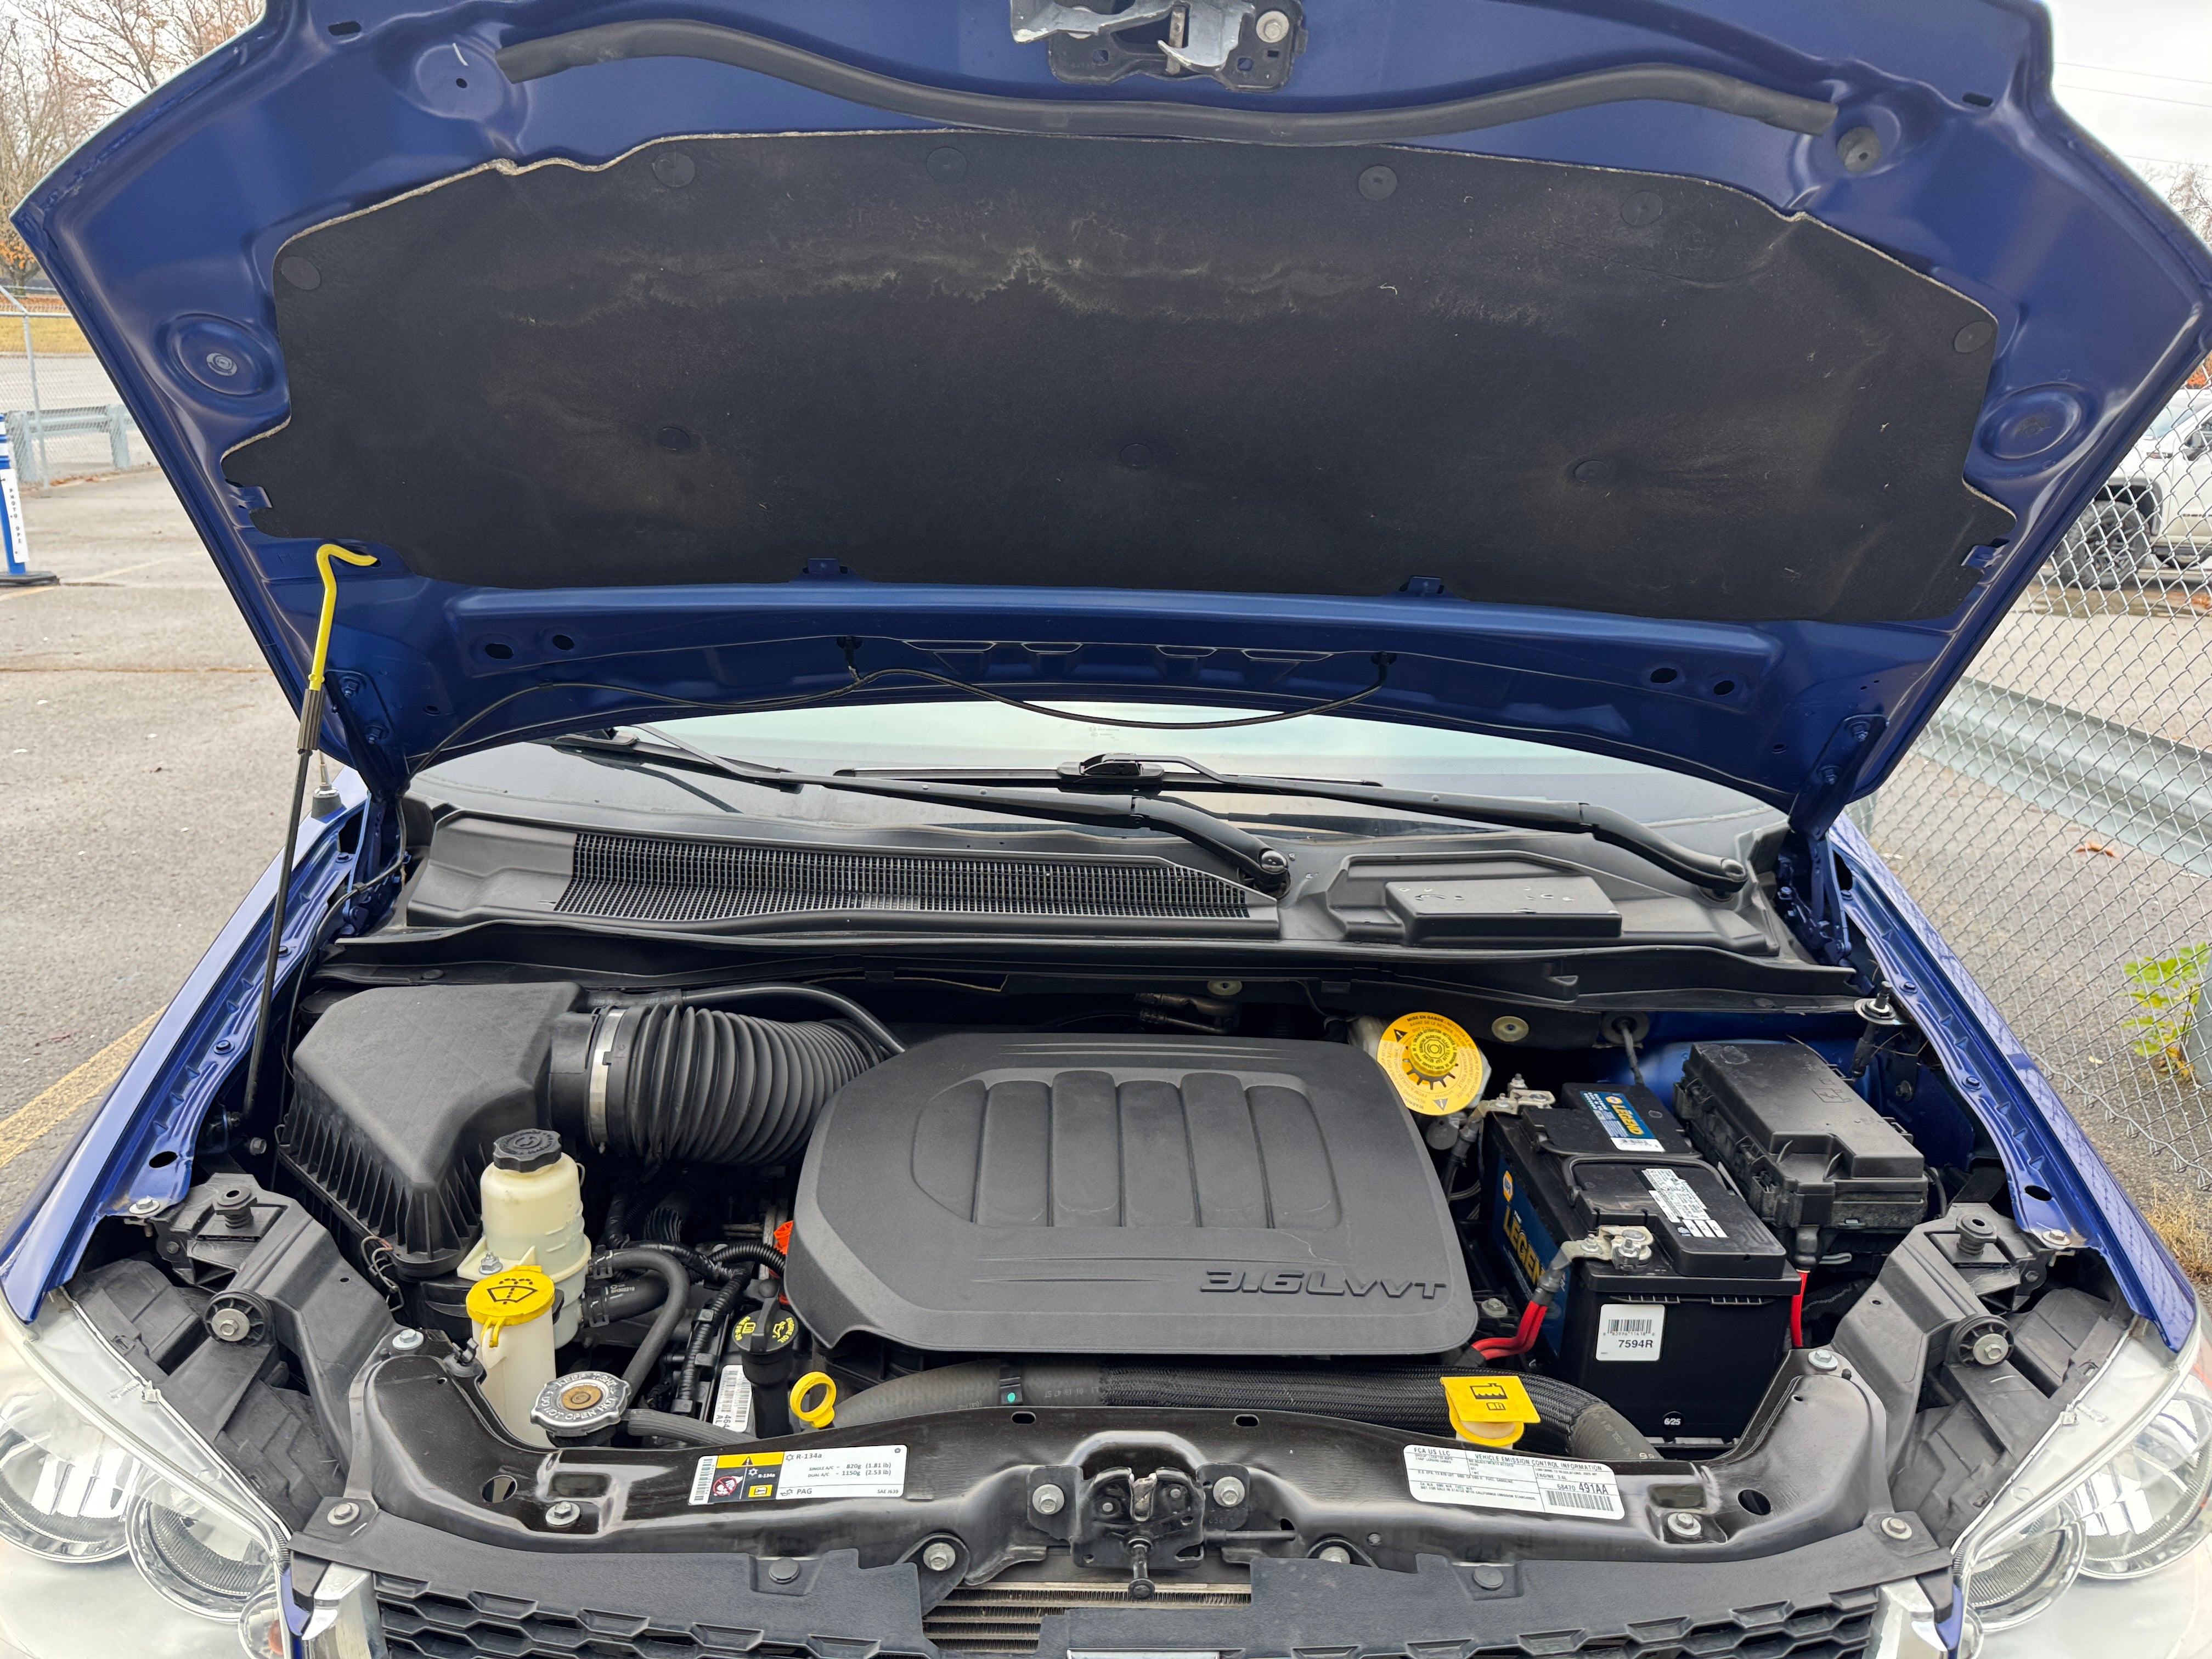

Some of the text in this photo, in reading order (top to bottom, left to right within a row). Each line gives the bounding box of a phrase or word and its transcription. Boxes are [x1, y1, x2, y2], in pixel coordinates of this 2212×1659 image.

[1611, 1104, 1644, 1135] LEGEND
[777, 1317, 795, 1343] ENGINE OIL
[1618, 1340, 1653, 1348] 7594R
[556, 1374, 586, 1387] KEEP
[565, 1409, 597, 1420] OPEN
[1532, 1460, 1559, 1468] CONTROL
[1561, 1463, 1602, 1471] INFORMATION
[1579, 1482, 1609, 1494] 491AA
